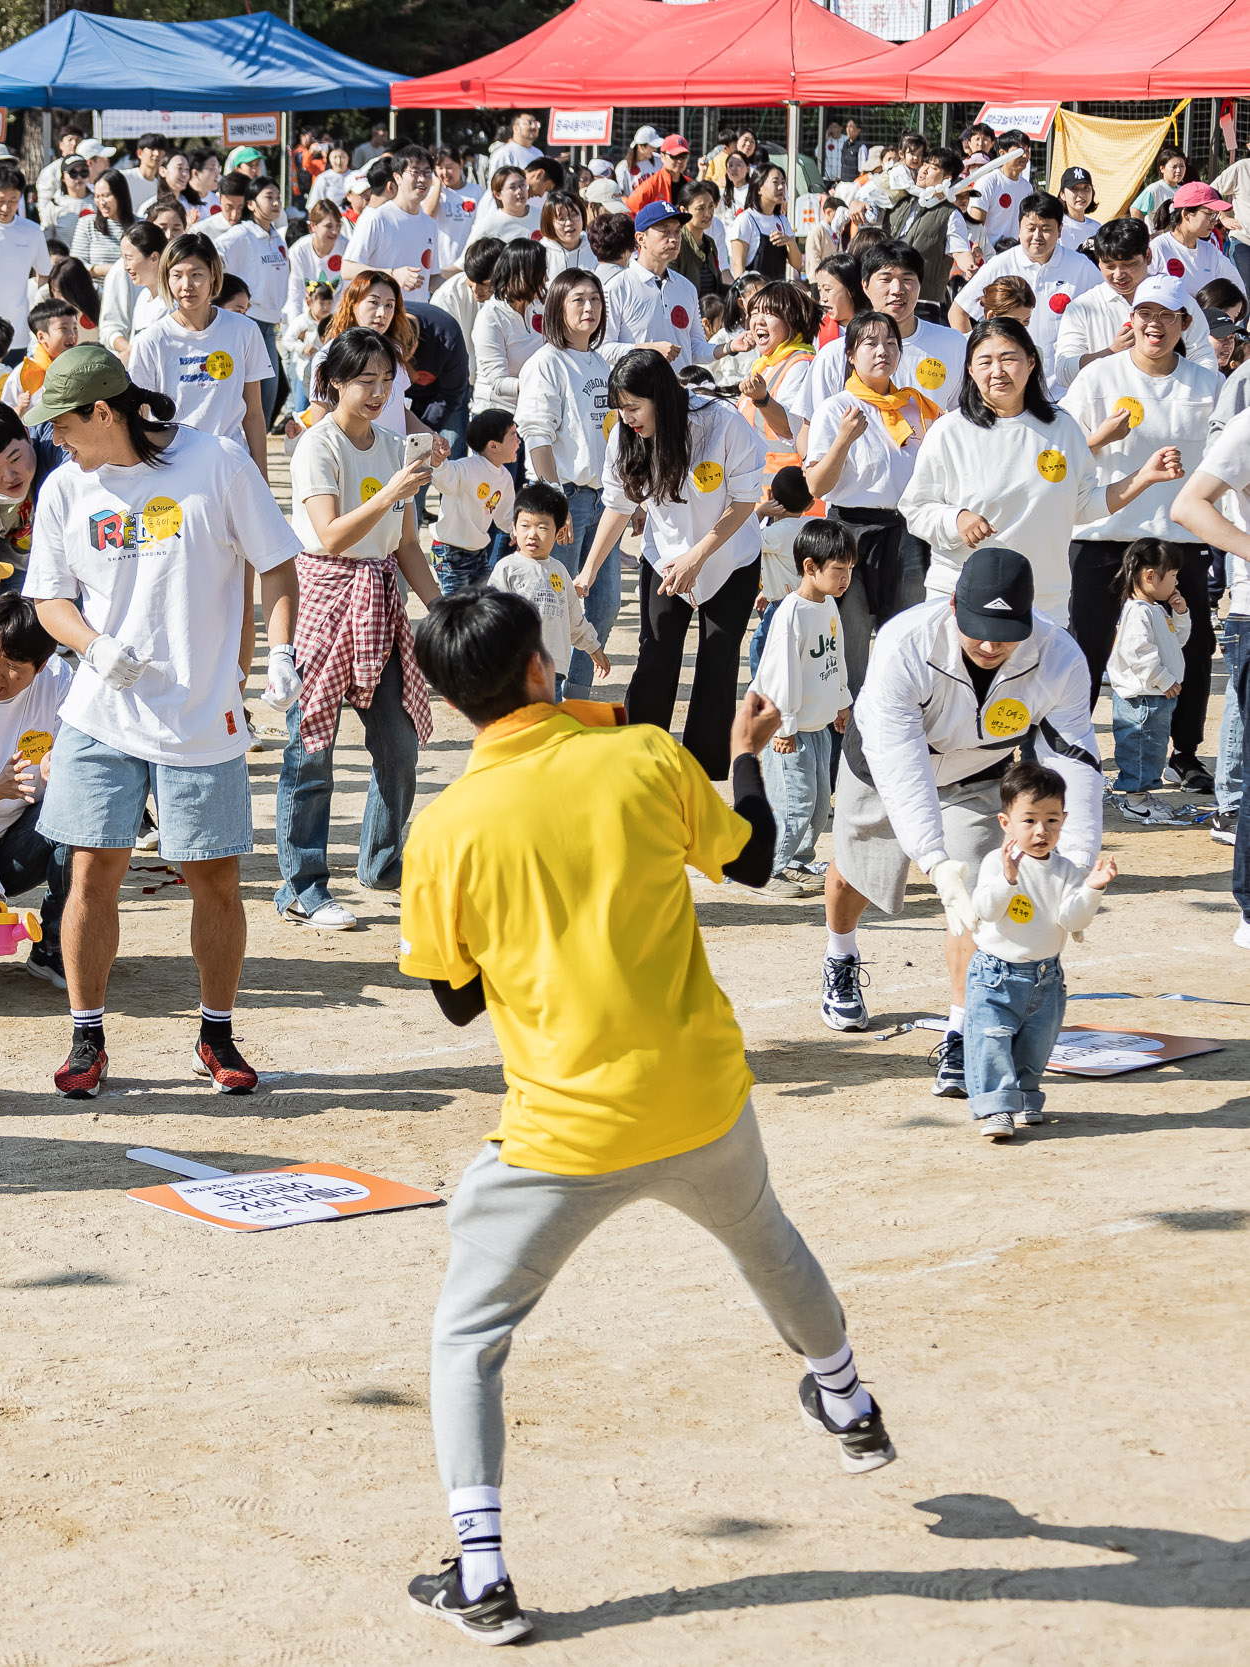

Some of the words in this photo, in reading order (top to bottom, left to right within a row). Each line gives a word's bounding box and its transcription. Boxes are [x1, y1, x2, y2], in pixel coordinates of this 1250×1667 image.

[213, 1180, 312, 1204] 어린이집
[220, 1187, 364, 1213] 리틀지니어스
[459, 1518, 475, 1528] NIKE
